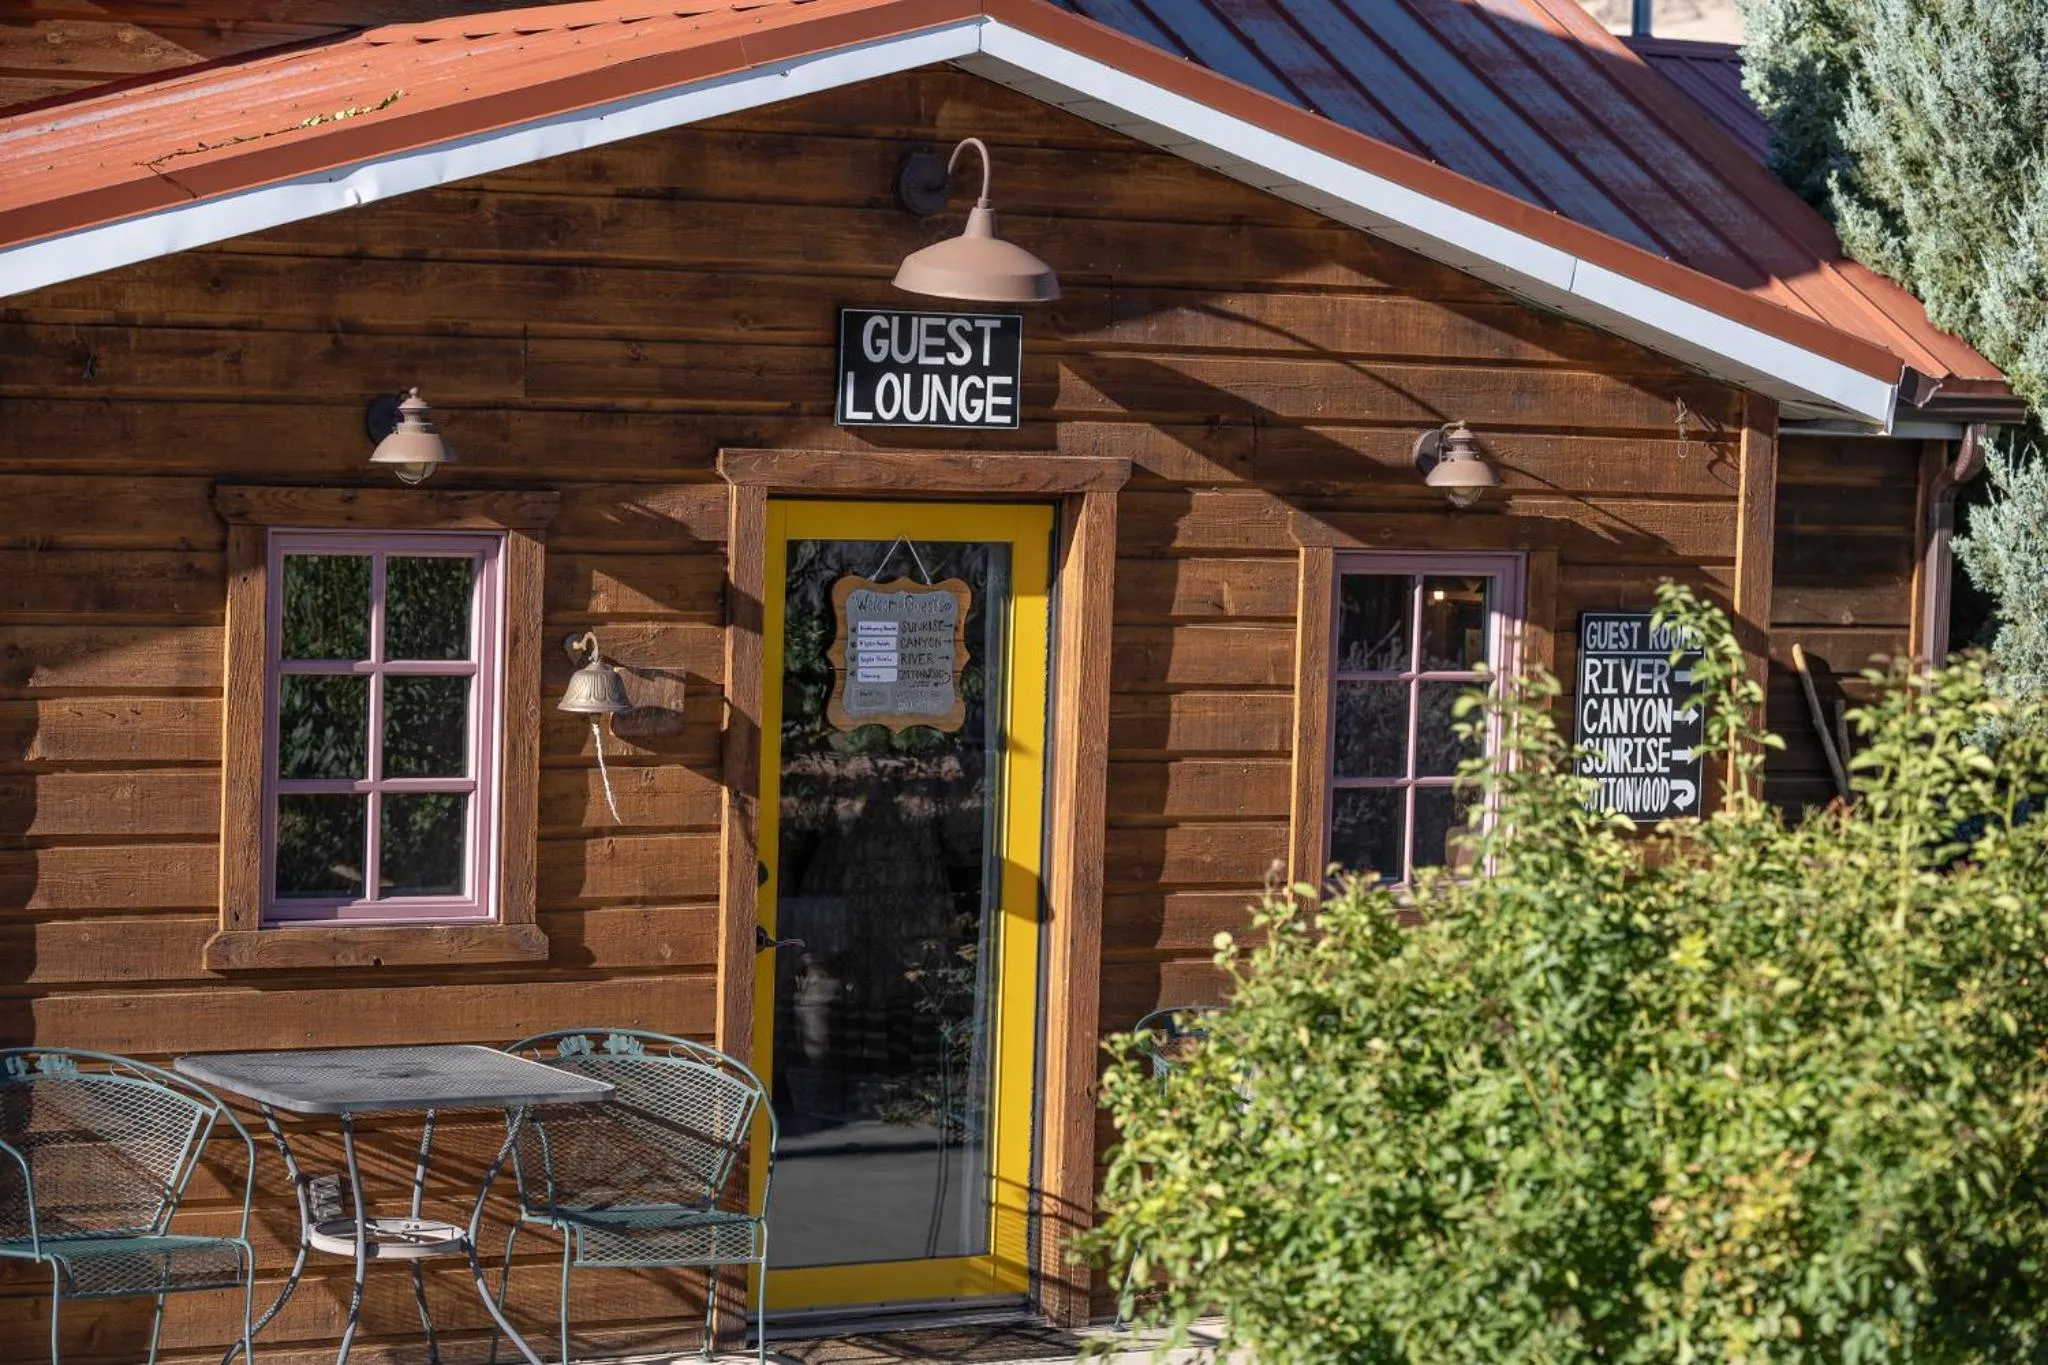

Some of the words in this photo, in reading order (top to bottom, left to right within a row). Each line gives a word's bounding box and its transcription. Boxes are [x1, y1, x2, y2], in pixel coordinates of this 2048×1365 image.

[862, 315, 1001, 366] GUEST
[845, 371, 1012, 423] LOUNGE
[900, 621, 945, 634] SUNRISE
[900, 638, 942, 649] CANYON
[1586, 621, 1641, 650] GUEST
[900, 654, 934, 665] RIVER
[1584, 658, 1670, 694] RIVER
[1583, 698, 1672, 734] CANYON
[1581, 737, 1671, 774] SUNRISE
[1582, 777, 1670, 813] OTTONWOOD
